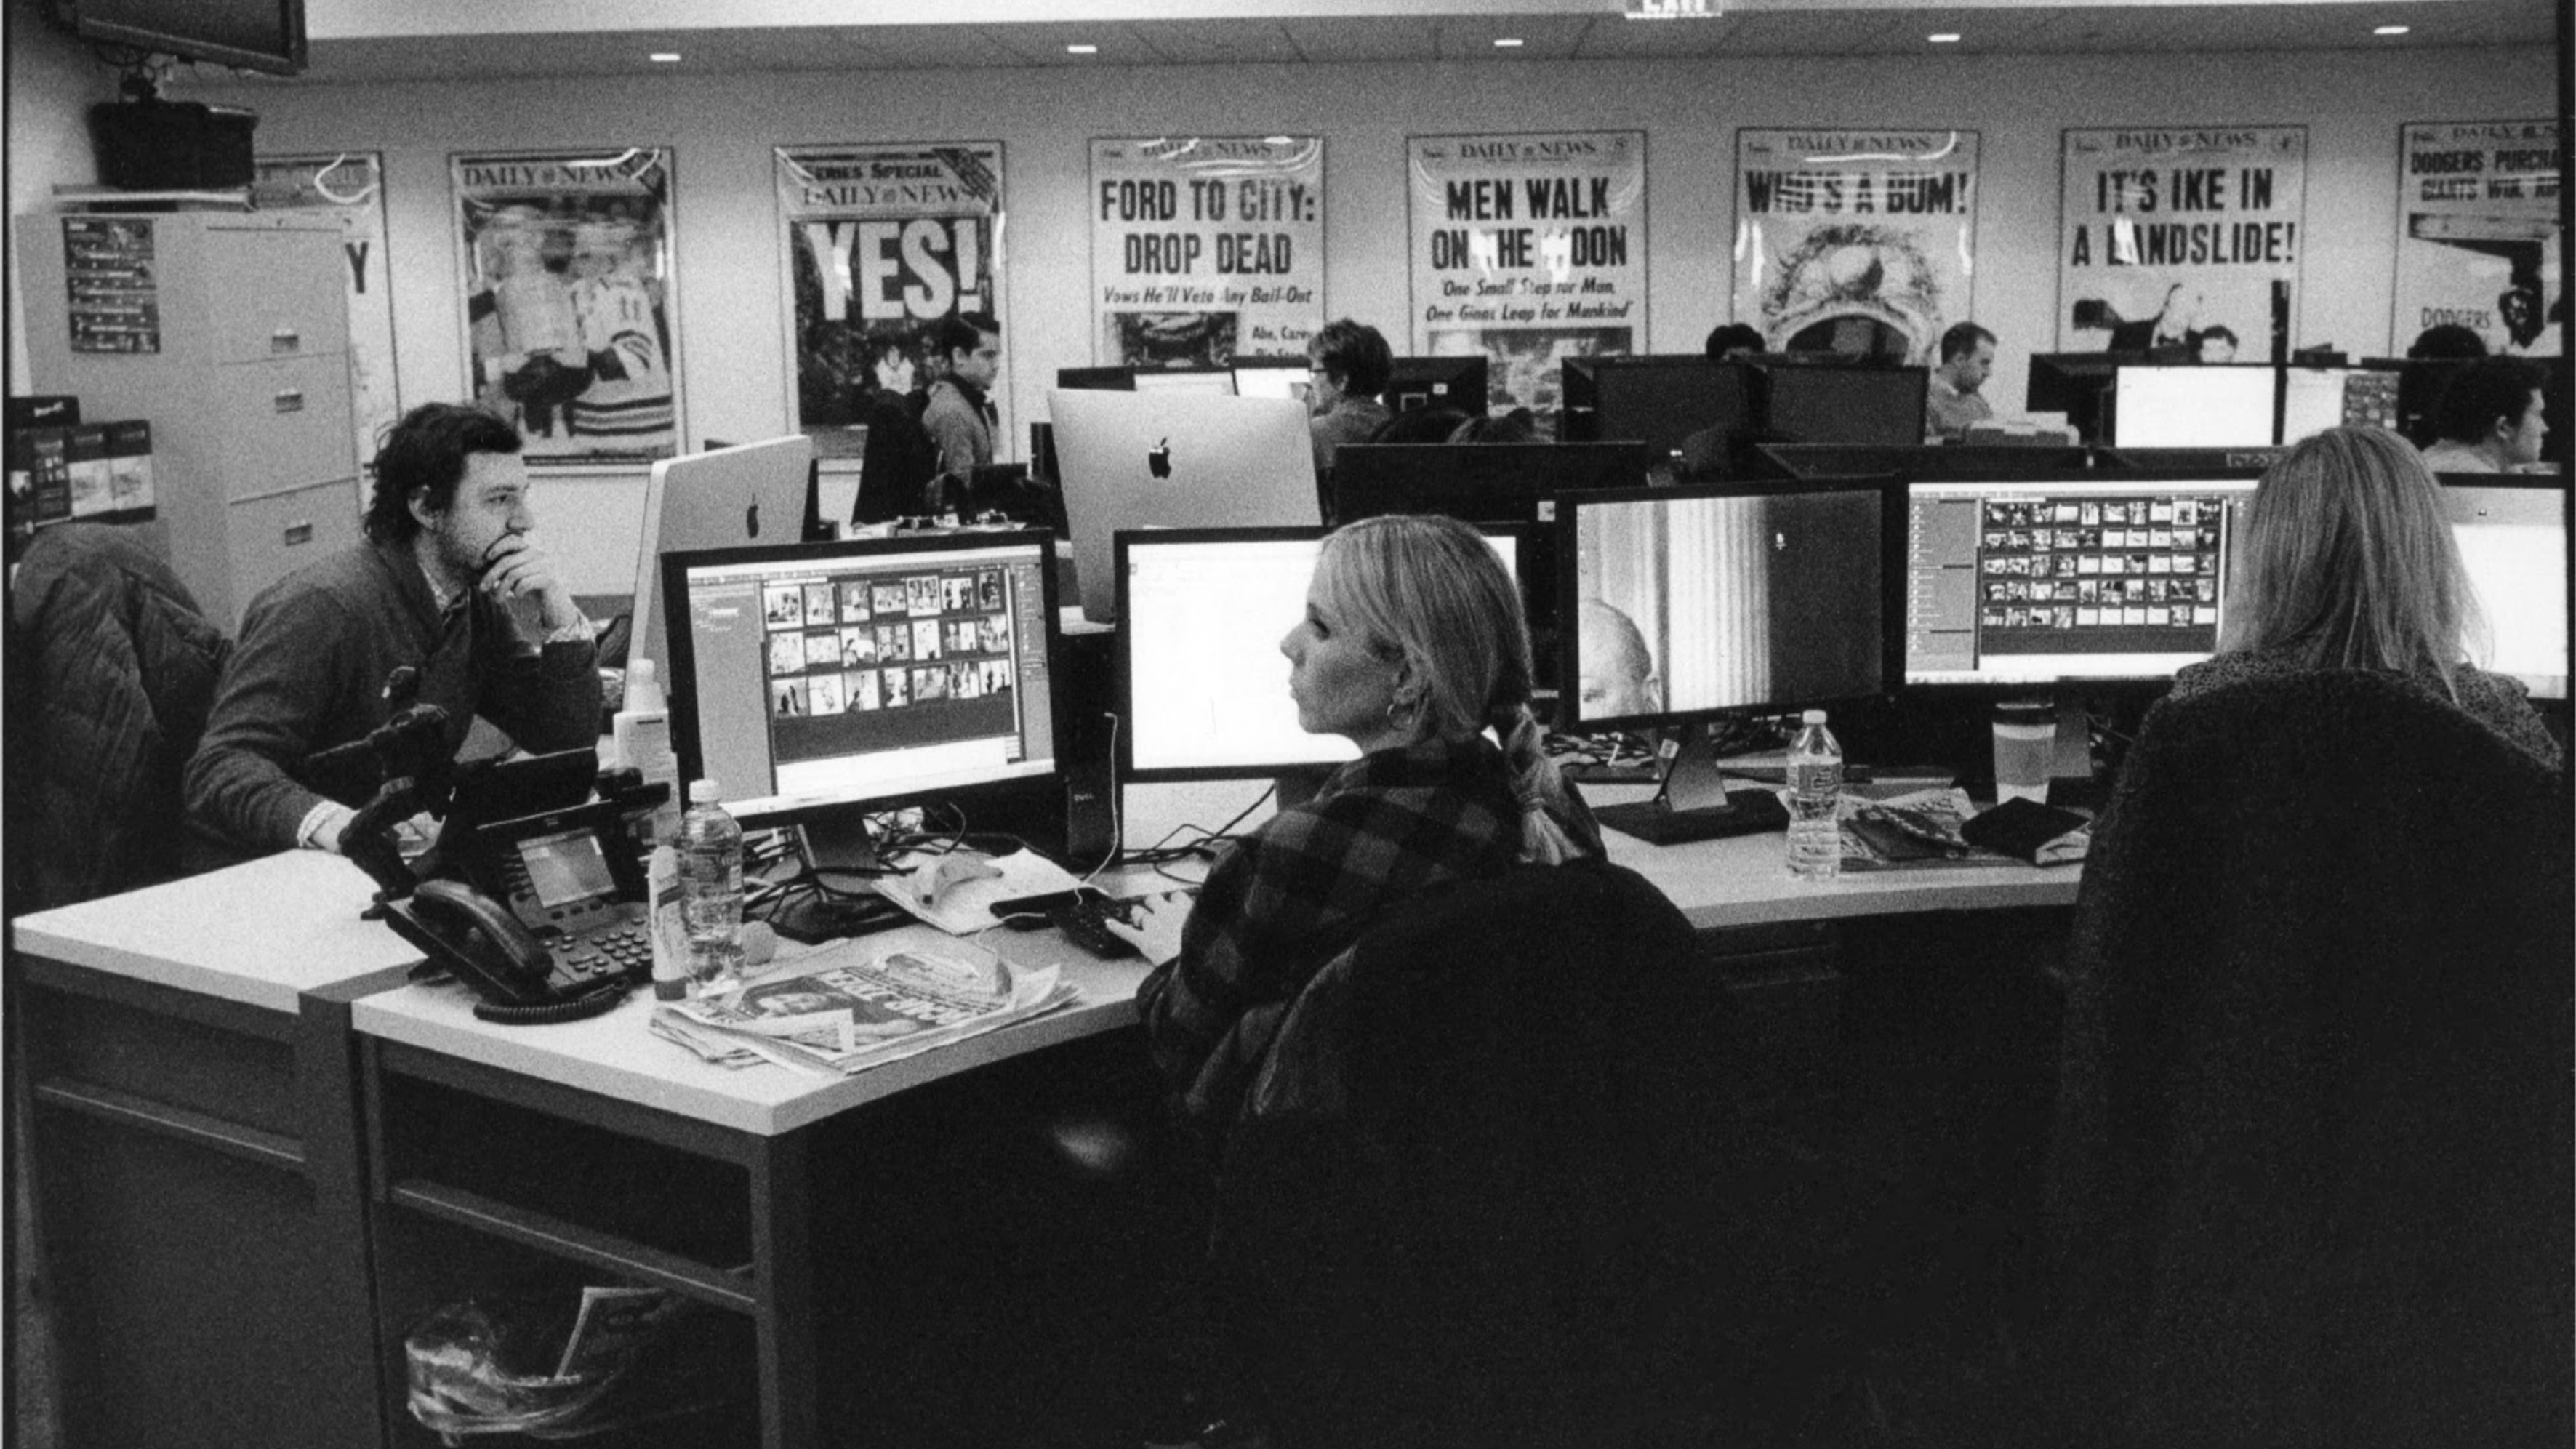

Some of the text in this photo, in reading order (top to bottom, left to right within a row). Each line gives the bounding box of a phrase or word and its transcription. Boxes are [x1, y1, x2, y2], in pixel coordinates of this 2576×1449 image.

[1461, 143, 1517, 158] DAILY
[1538, 141, 1597, 155] NEWS
[2410, 150, 2484, 174] DODGERS
[463, 165, 620, 186] DAILY NEW
[1855, 172, 1874, 213] A
[1886, 172, 1968, 214] BUM!
[2098, 167, 2273, 212] IT'S IKE IN
[1100, 179, 1315, 222] FORD TO CITY:
[1447, 177, 1610, 220] MEN WALK
[1124, 233, 1291, 274] DROP DEAD
[1431, 225, 1627, 270] ON HE OON
[2072, 225, 2091, 266] A
[807, 219, 982, 321] YES!
[1521, 277, 1552, 297] Sep
[1104, 286, 1139, 304] Vows
[1183, 286, 1215, 304] Veto
[1501, 303, 1536, 322] Leap
[1541, 302, 1561, 319] for
[2421, 307, 2492, 329] DODGERS
